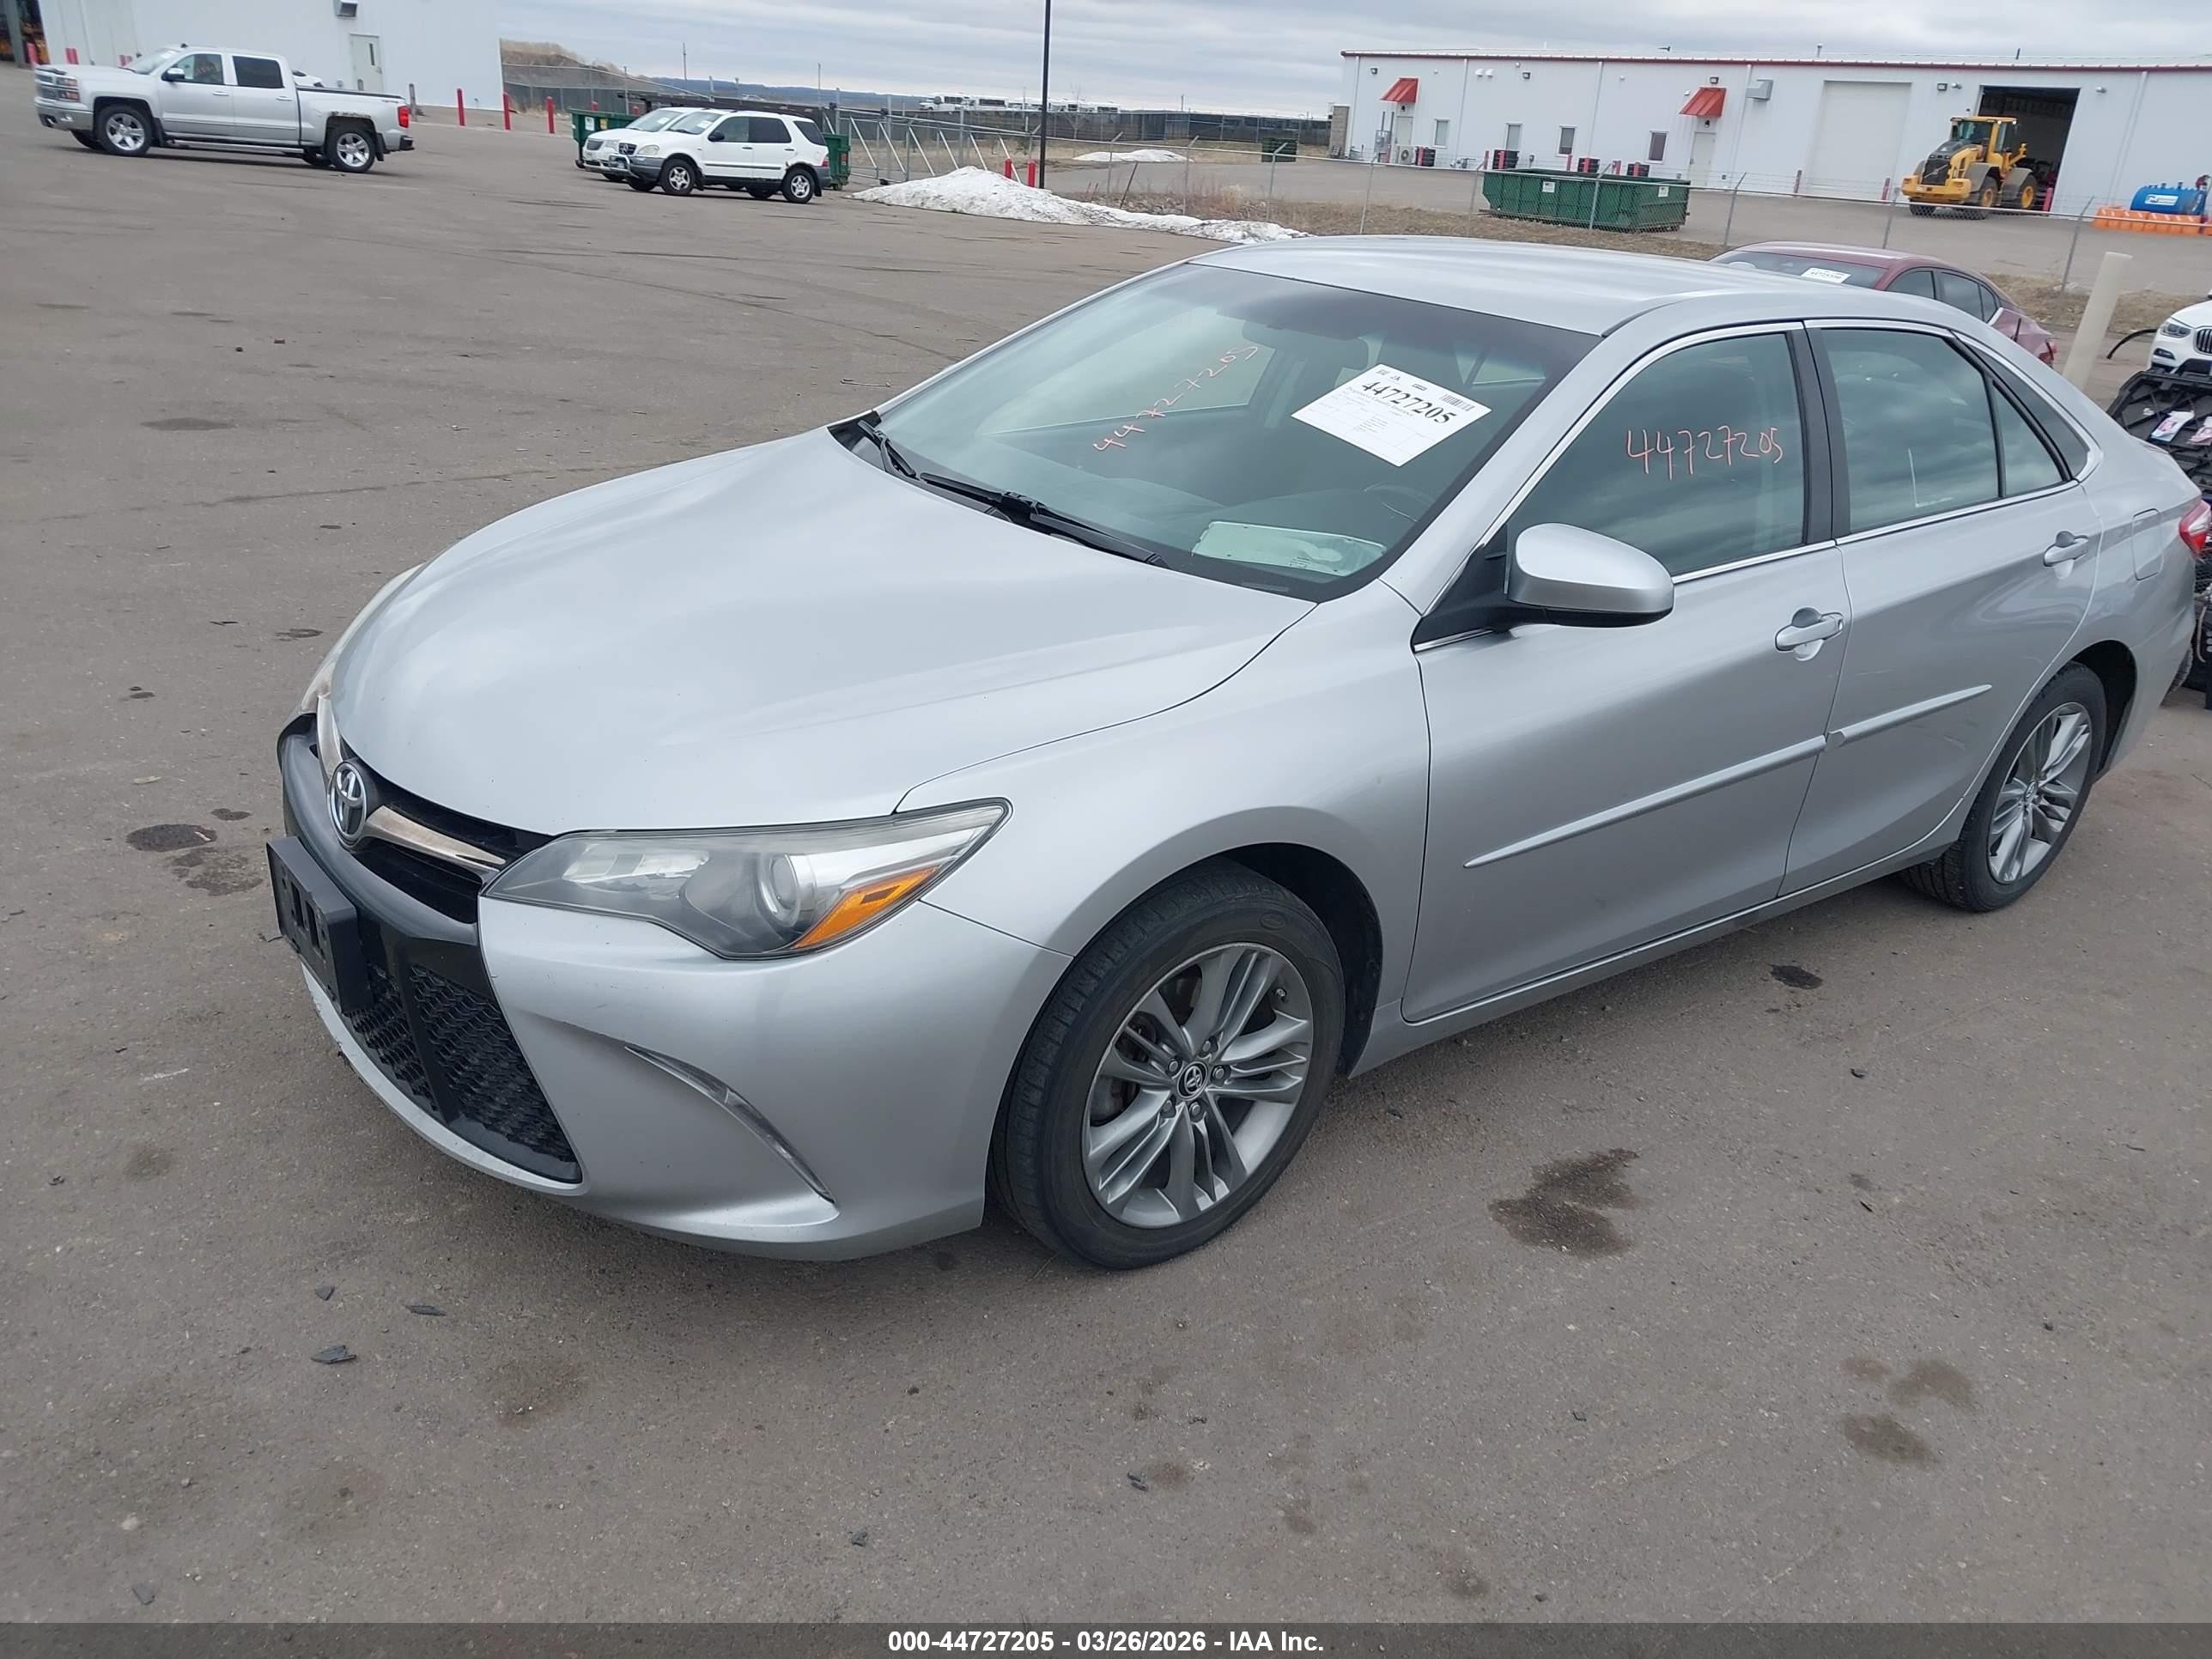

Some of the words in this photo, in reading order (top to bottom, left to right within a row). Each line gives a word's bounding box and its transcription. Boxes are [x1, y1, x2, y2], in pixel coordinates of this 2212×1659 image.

[1092, 346, 1257, 451] 44727205
[1361, 381, 1457, 424] 44727205
[1627, 425, 1784, 481] 44727205
